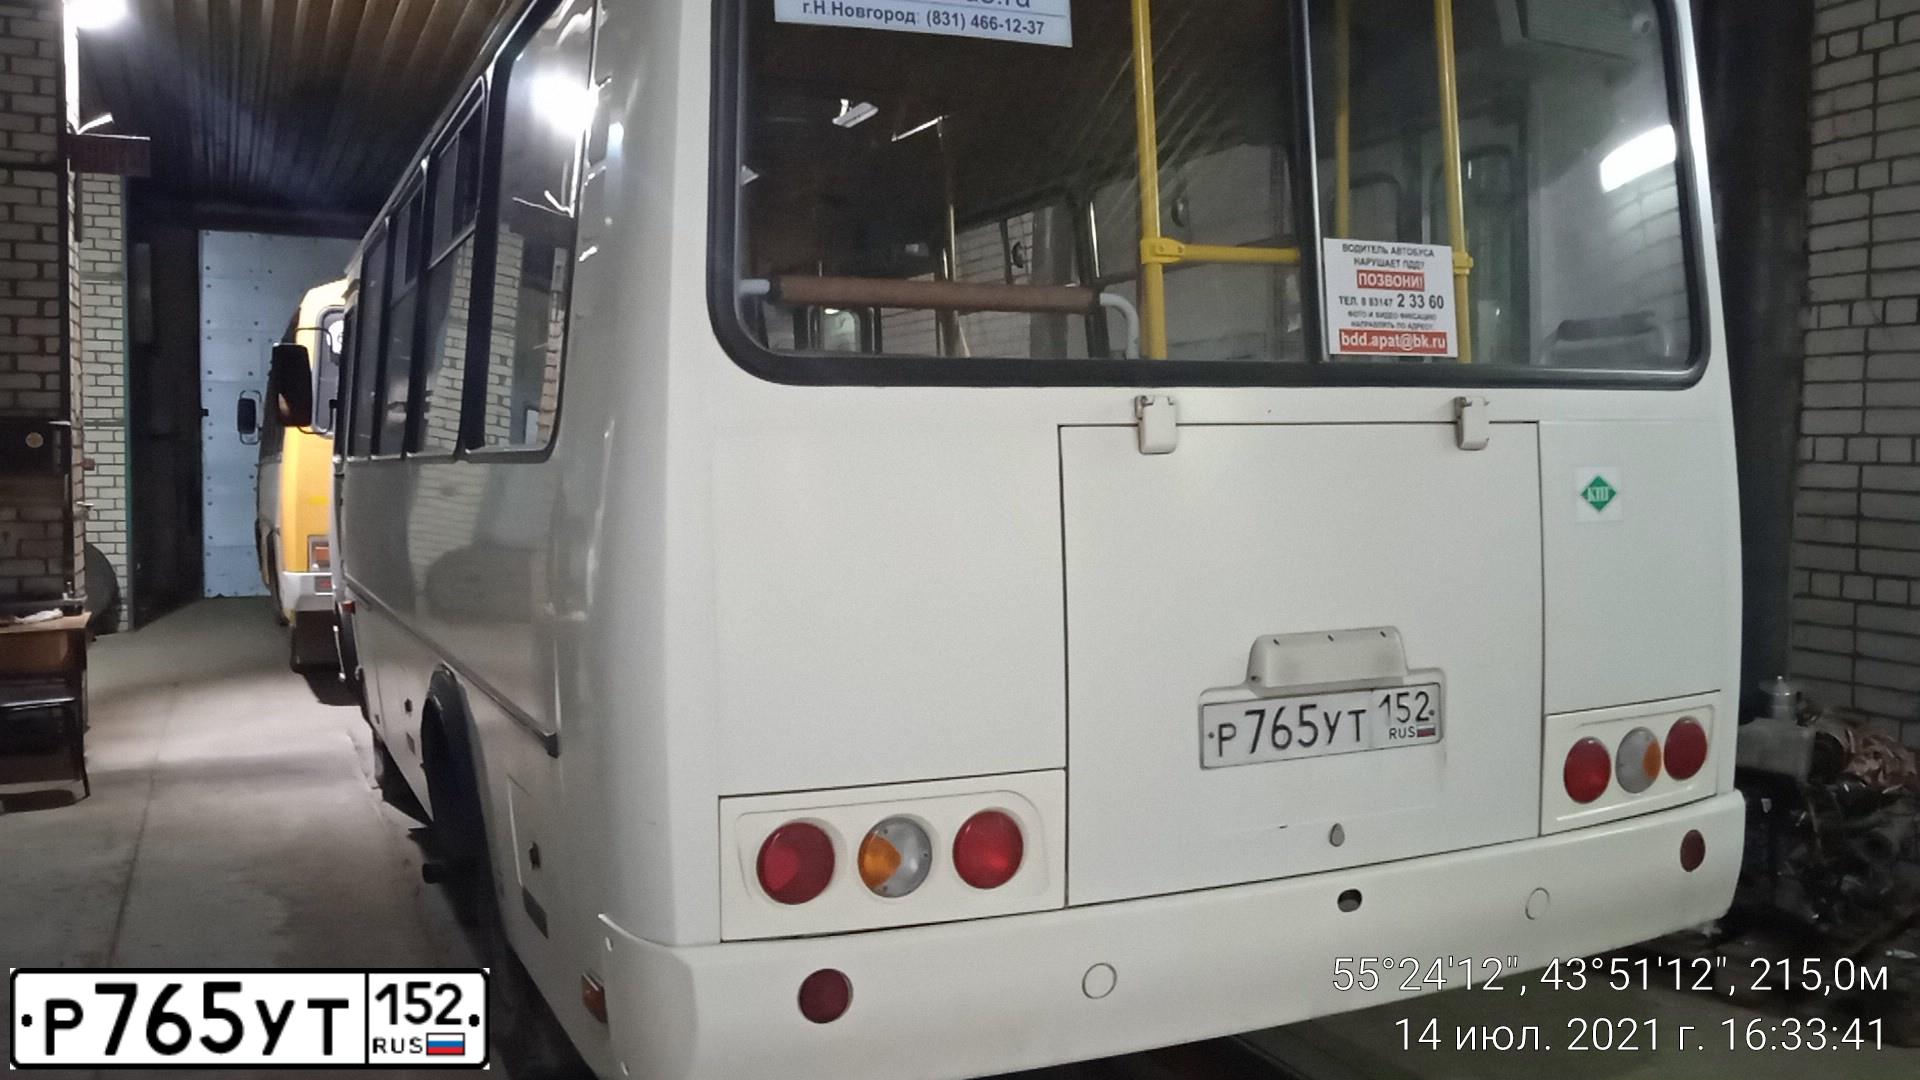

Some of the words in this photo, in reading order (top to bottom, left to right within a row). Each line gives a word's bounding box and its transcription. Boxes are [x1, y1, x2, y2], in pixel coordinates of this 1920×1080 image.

[927, 10, 966, 31] (831)
[971, 14, 1044, 35] 466-12-37
[1342, 243, 1389, 255] ВОДИТЕЛЬ
[1391, 246, 1435, 257] АВТОБУСА
[1354, 257, 1400, 268] НАРУШАЕТ
[1358, 272, 1423, 289] ПОЗВОНИ!
[1397, 293, 1405, 308] 2
[1409, 294, 1425, 309] 33
[1429, 295, 1445, 310] 60
[1341, 332, 1445, 351] bdd.apat@bk.ru
[1379, 691, 1430, 723] 152
[1389, 726, 1416, 740] RUS
